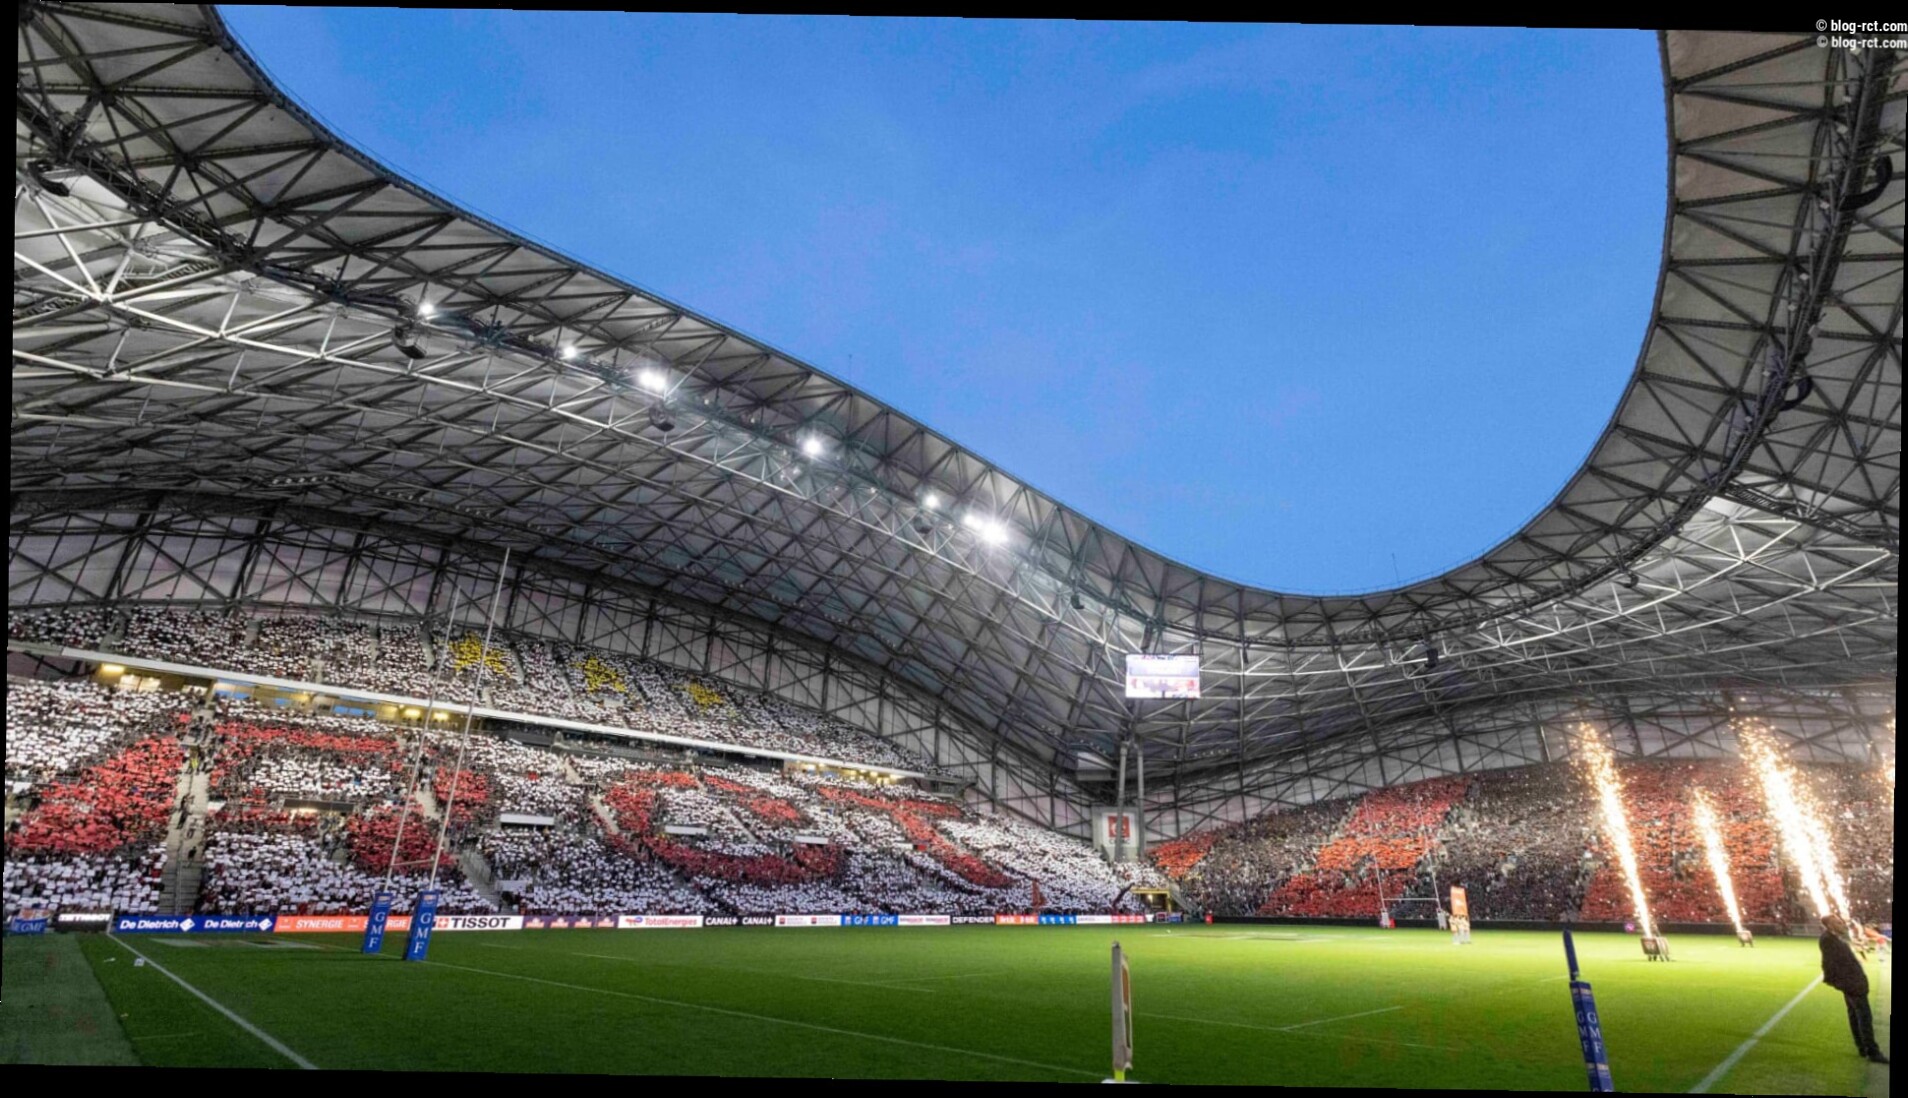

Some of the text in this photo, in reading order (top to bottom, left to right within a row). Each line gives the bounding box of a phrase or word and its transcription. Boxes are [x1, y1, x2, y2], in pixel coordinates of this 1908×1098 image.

[120, 919, 179, 930] De Dietrich
[204, 919, 258, 928] De Dietrch
[296, 919, 344, 929] SYNERGIE
[452, 917, 511, 929] TISSOT
[645, 917, 697, 927] TotalEnergies
[705, 916, 738, 925] CANAL+
[742, 916, 773, 925] CANAL+
[880, 916, 894, 925] GMF
[952, 916, 994, 924] DEFENDER
[369, 911, 385, 948] GMF
[414, 912, 432, 954] GMF
[1587, 1011, 1602, 1053] GMF
